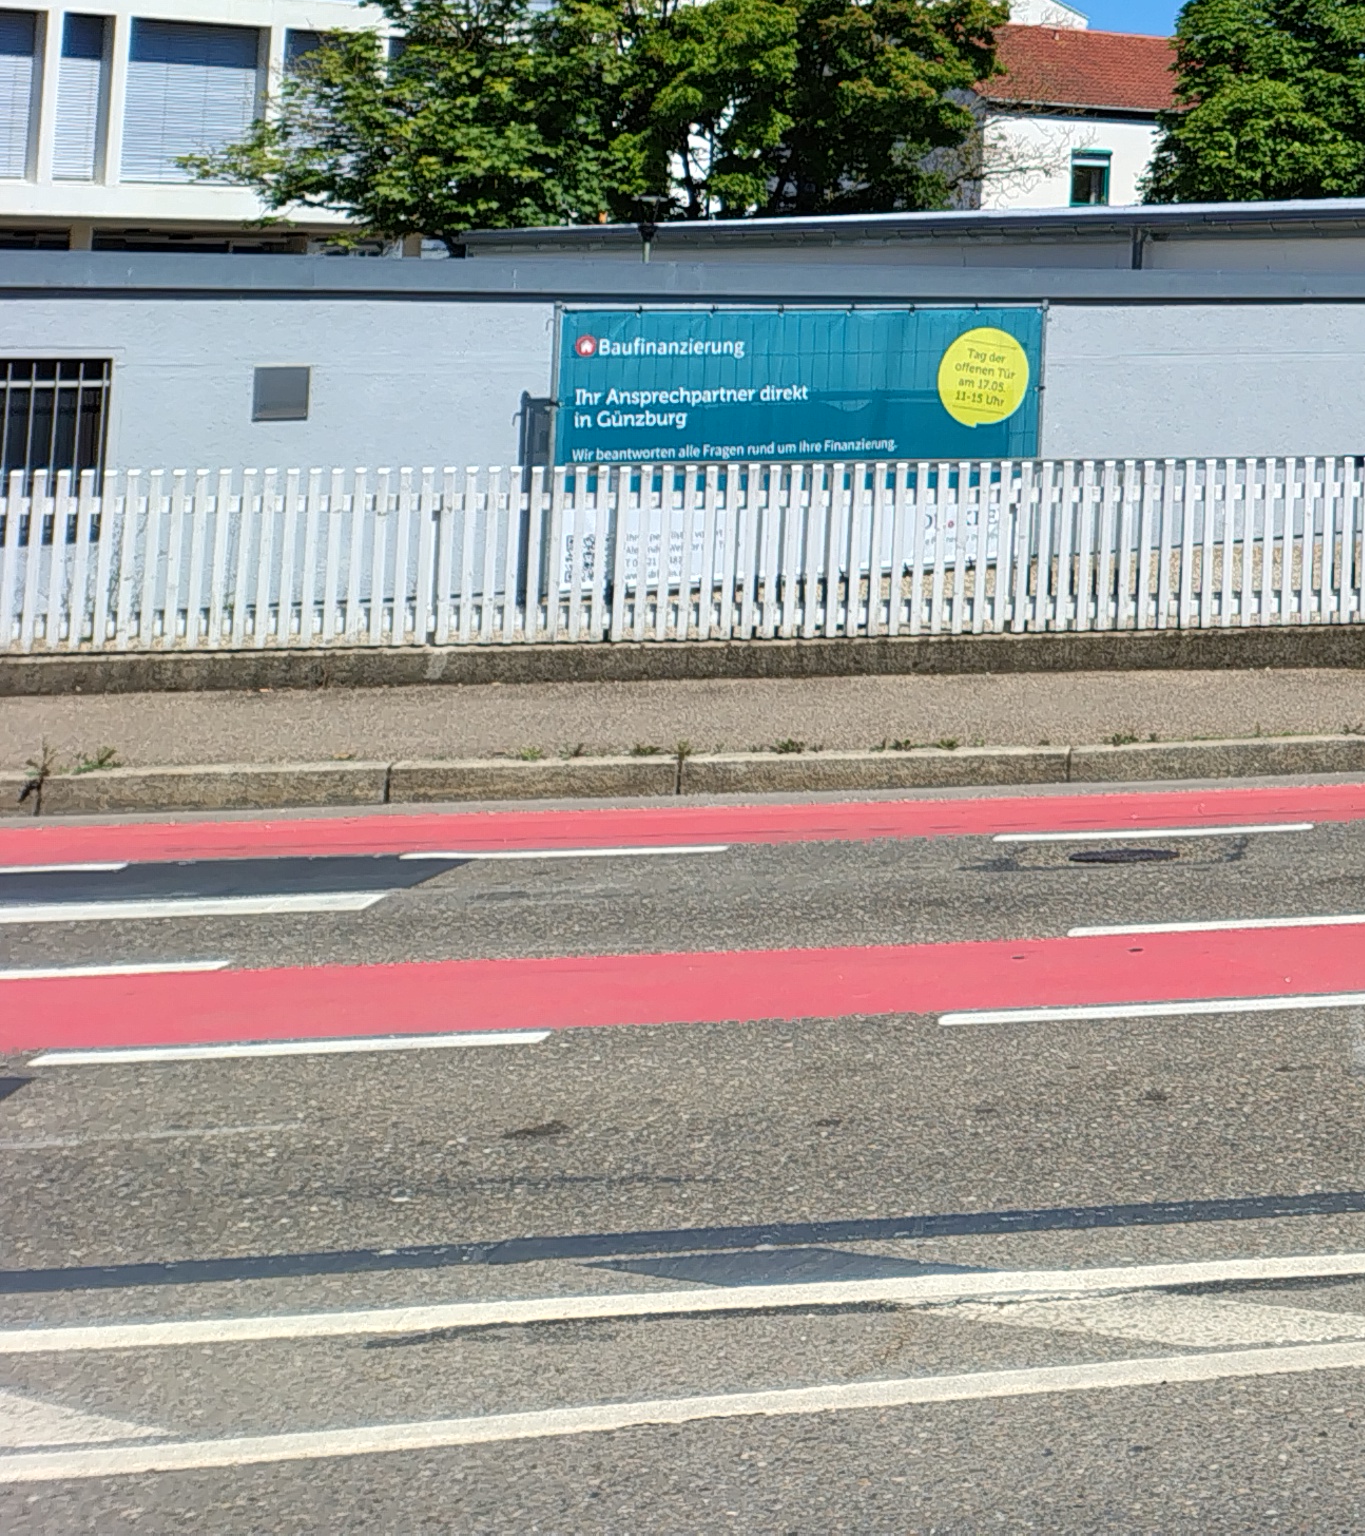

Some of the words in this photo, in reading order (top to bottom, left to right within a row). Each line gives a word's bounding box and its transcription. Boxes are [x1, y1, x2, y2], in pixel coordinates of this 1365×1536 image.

[598, 336, 745, 359] Baufinanzierung
[967, 348, 987, 363] Tag
[989, 352, 1006, 363] der
[955, 362, 995, 377] offenen
[998, 366, 1016, 379] Tür
[958, 378, 975, 388] am
[978, 378, 1006, 393] 17.05.
[575, 388, 601, 406] Ihr
[605, 386, 755, 408] Ansprechpartner
[759, 384, 809, 402] direkt
[955, 390, 983, 403] 11-15
[986, 394, 1005, 407] Uhr
[574, 411, 592, 428] in
[597, 409, 688, 430] Günzburg
[571, 448, 594, 462] Wir
[596, 446, 676, 461] beantworten
[678, 444, 701, 458] alle
[703, 444, 745, 459] Fragen
[747, 442, 774, 455] rund
[777, 444, 797, 455] um
[800, 440, 822, 453] Ihre
[824, 438, 898, 453] Finanzierung.
